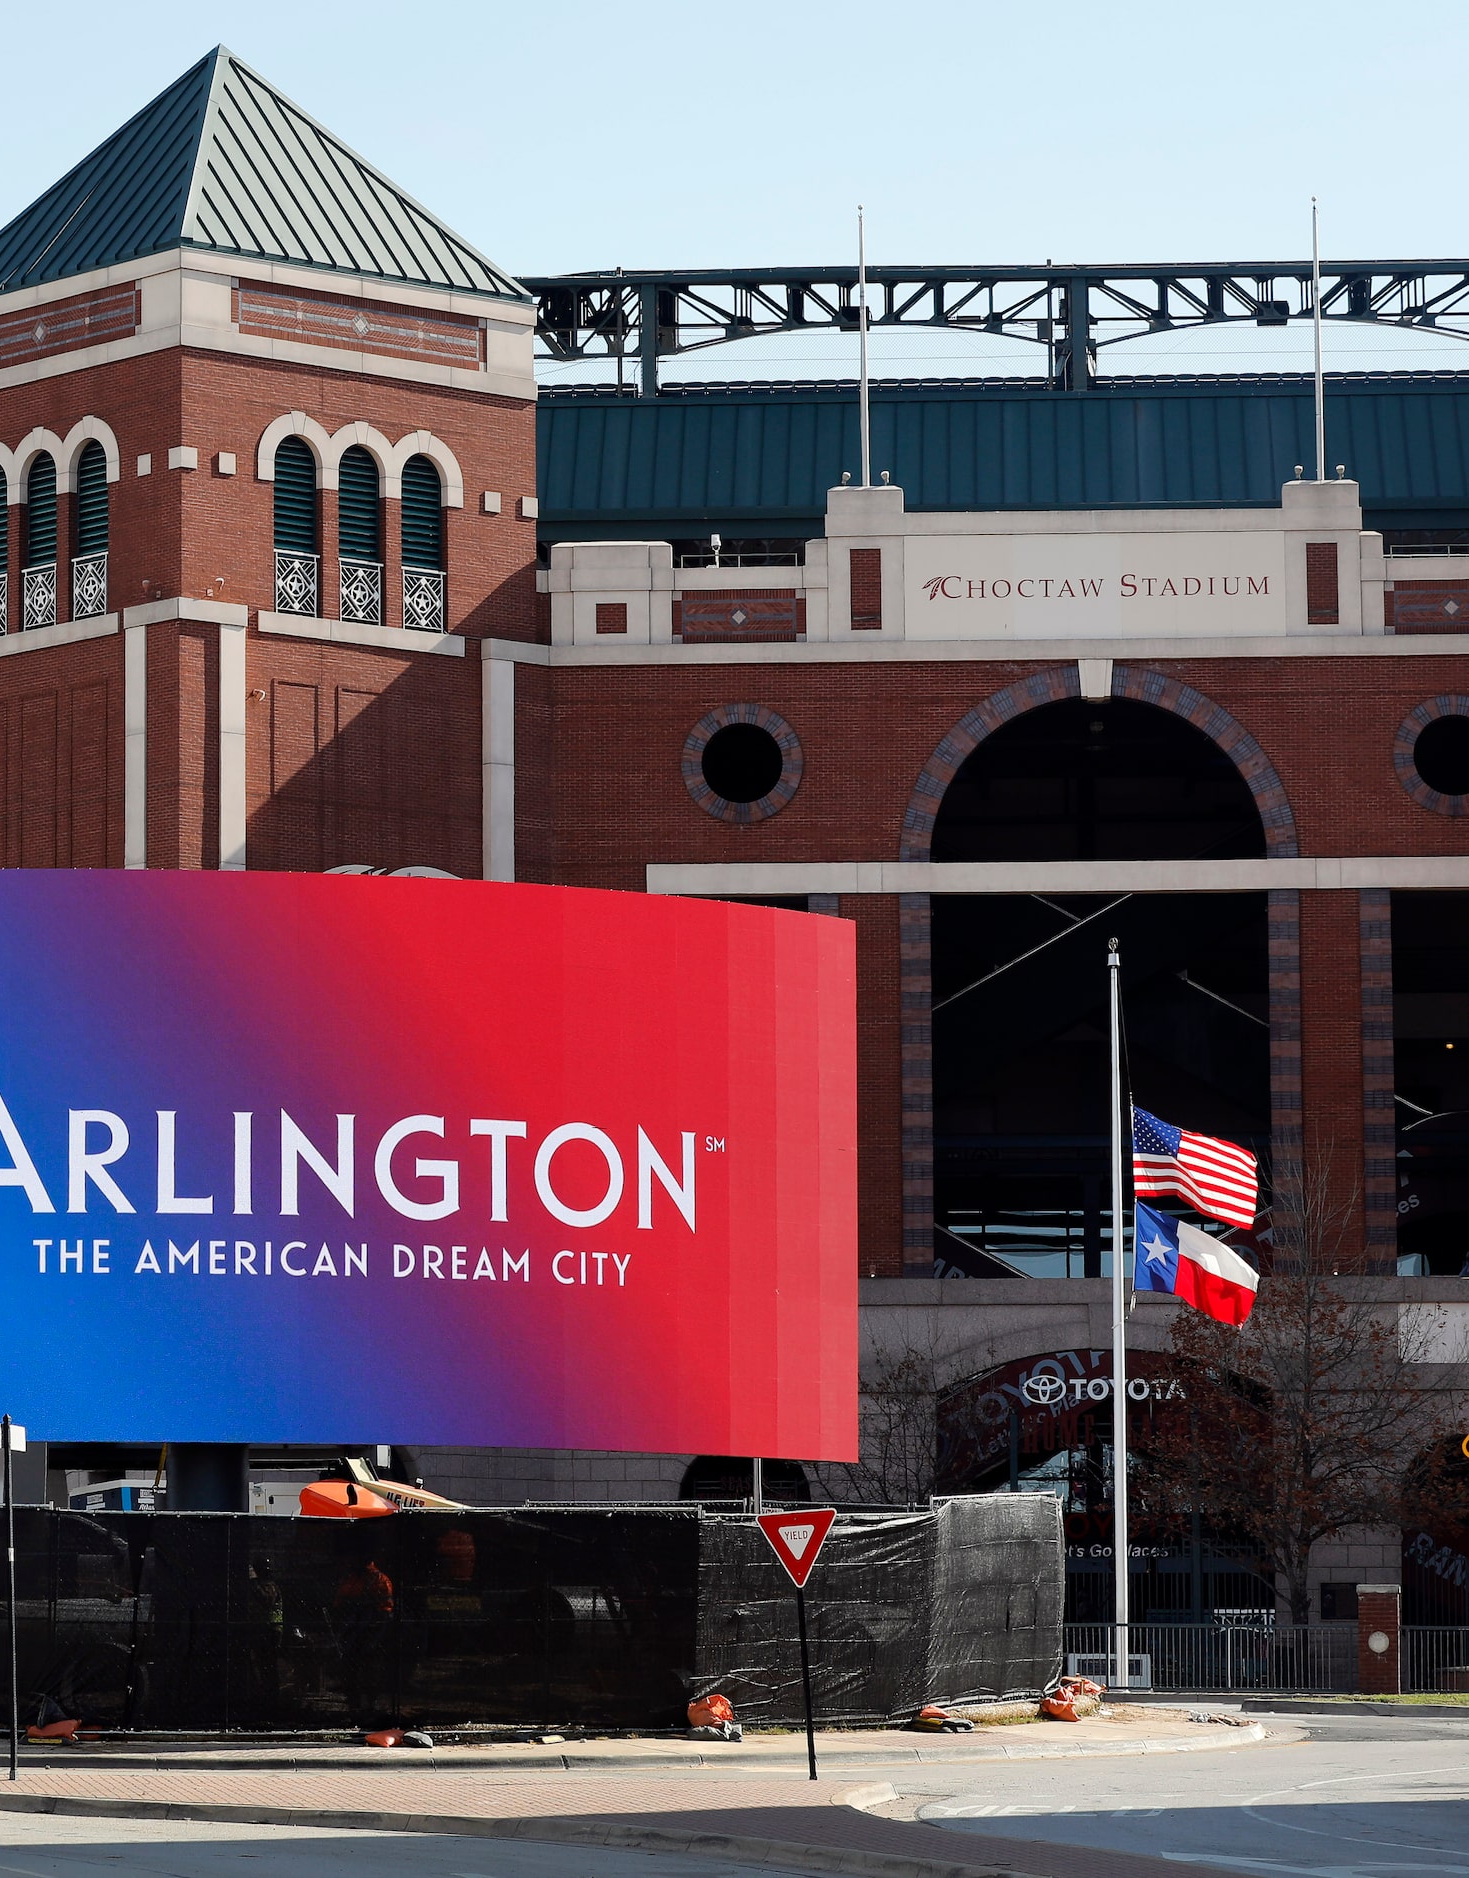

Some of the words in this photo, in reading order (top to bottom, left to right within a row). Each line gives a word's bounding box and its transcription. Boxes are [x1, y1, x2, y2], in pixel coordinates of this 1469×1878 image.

[939, 574, 1105, 600] CHOCTAW
[1120, 573, 1271, 597] STADIUM
[705, 1135, 726, 1153] SM
[32, 1239, 110, 1274] THE
[135, 1239, 370, 1278] AMERICAN
[393, 1244, 530, 1282] DREAM
[552, 1250, 632, 1288] CITY
[784, 1530, 808, 1541] YIELD
[1089, 1543, 1113, 1558] Go
